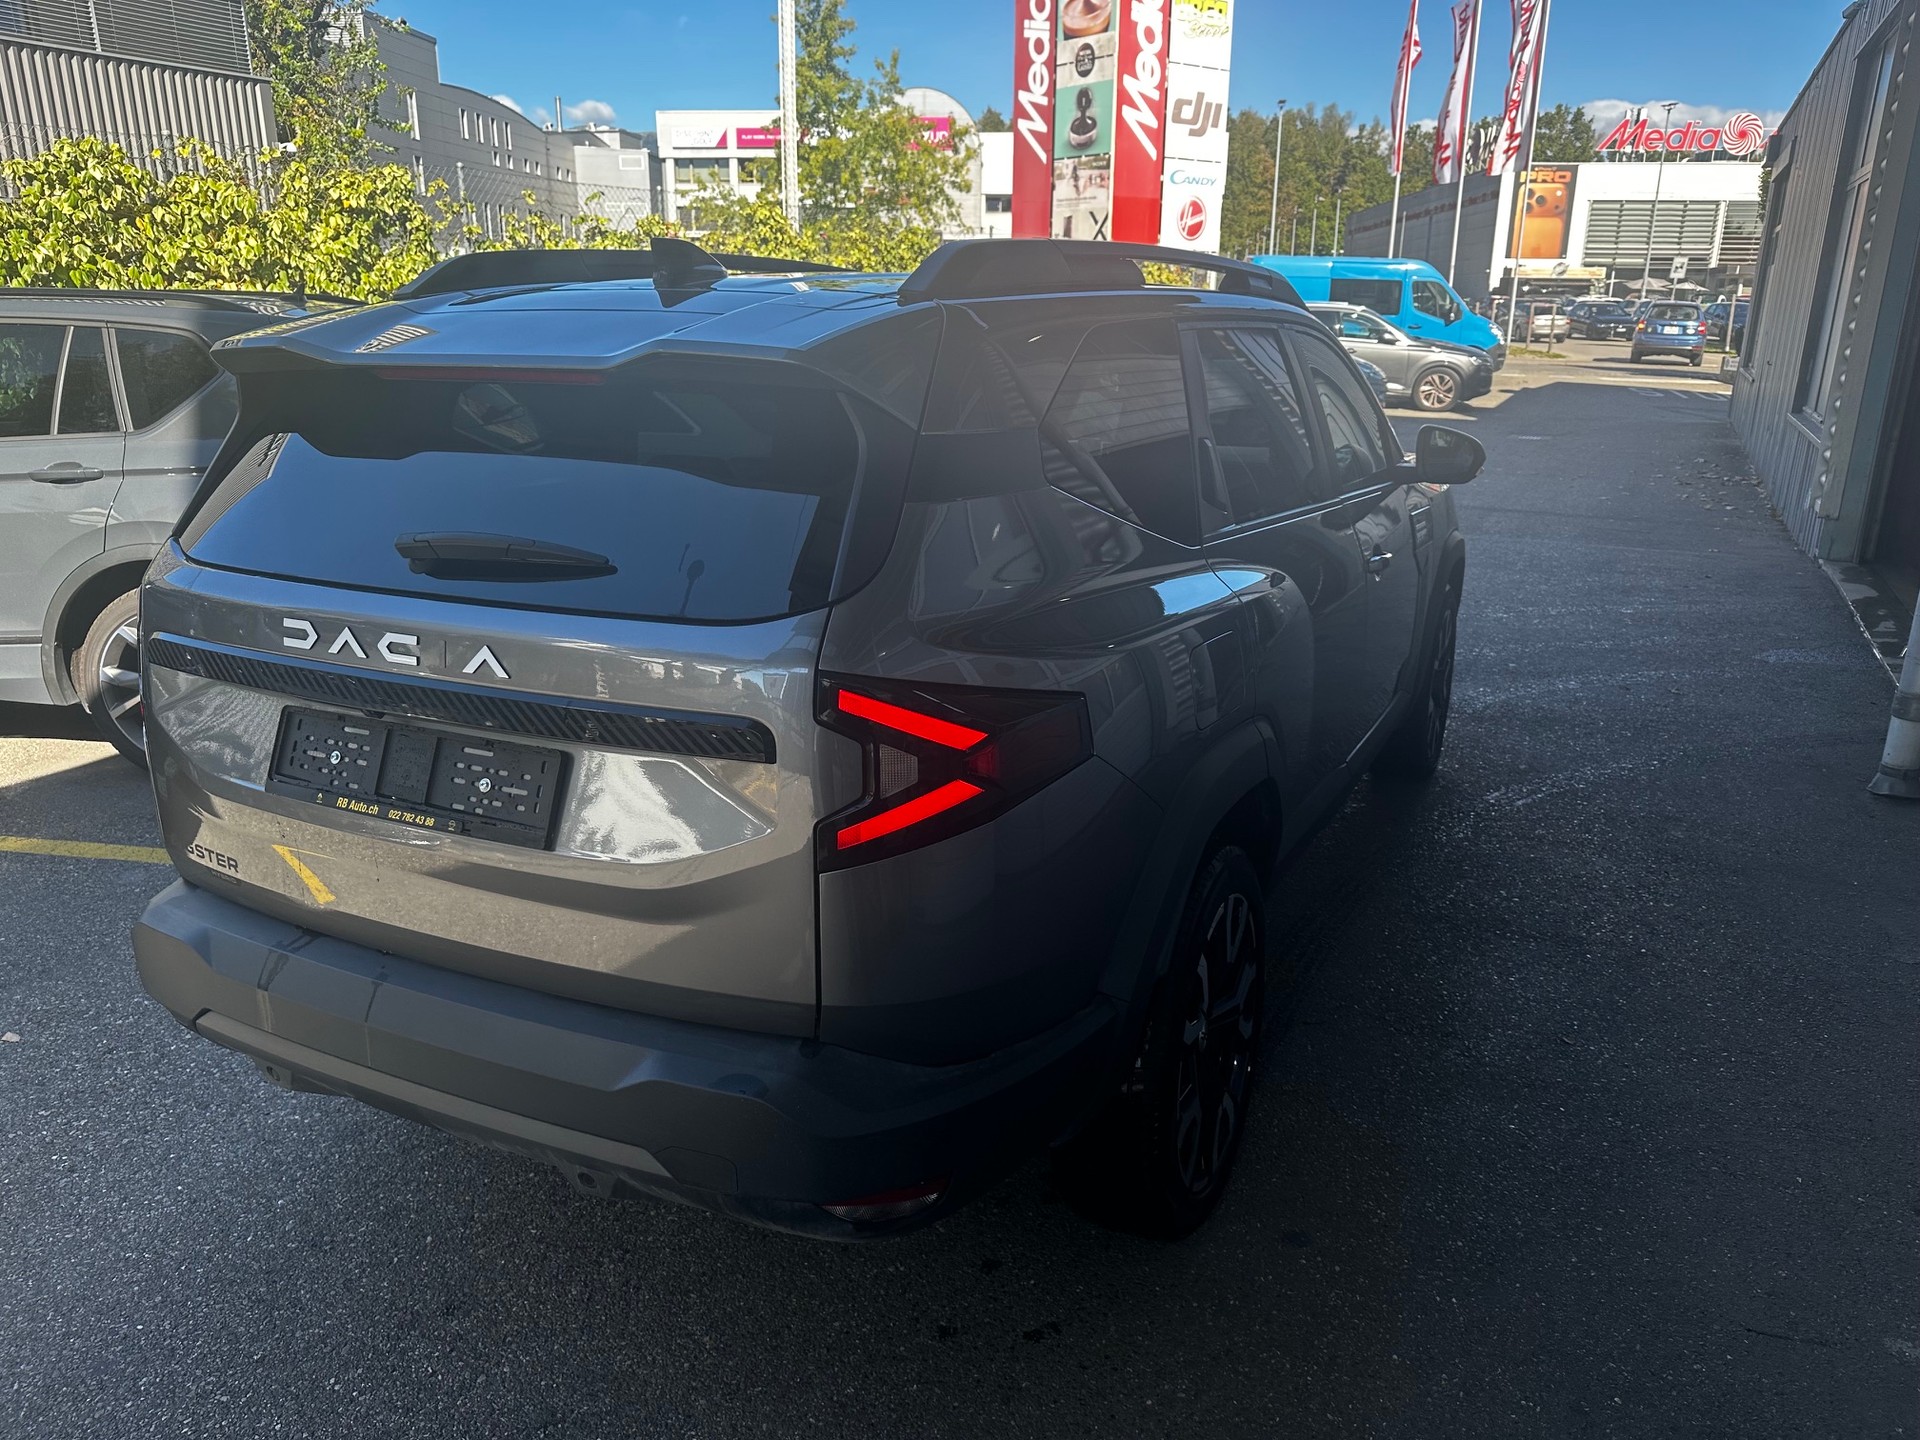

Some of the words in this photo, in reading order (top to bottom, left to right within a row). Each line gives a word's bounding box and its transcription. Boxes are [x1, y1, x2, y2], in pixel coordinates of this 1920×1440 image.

[1597, 117, 1723, 151] Media
[1520, 171, 1572, 183] PRO
[336, 797, 347, 808] RB
[349, 800, 379, 815] Auto.ch
[388, 809, 401, 819] 022
[402, 812, 414, 823] 782
[415, 815, 424, 824] 43
